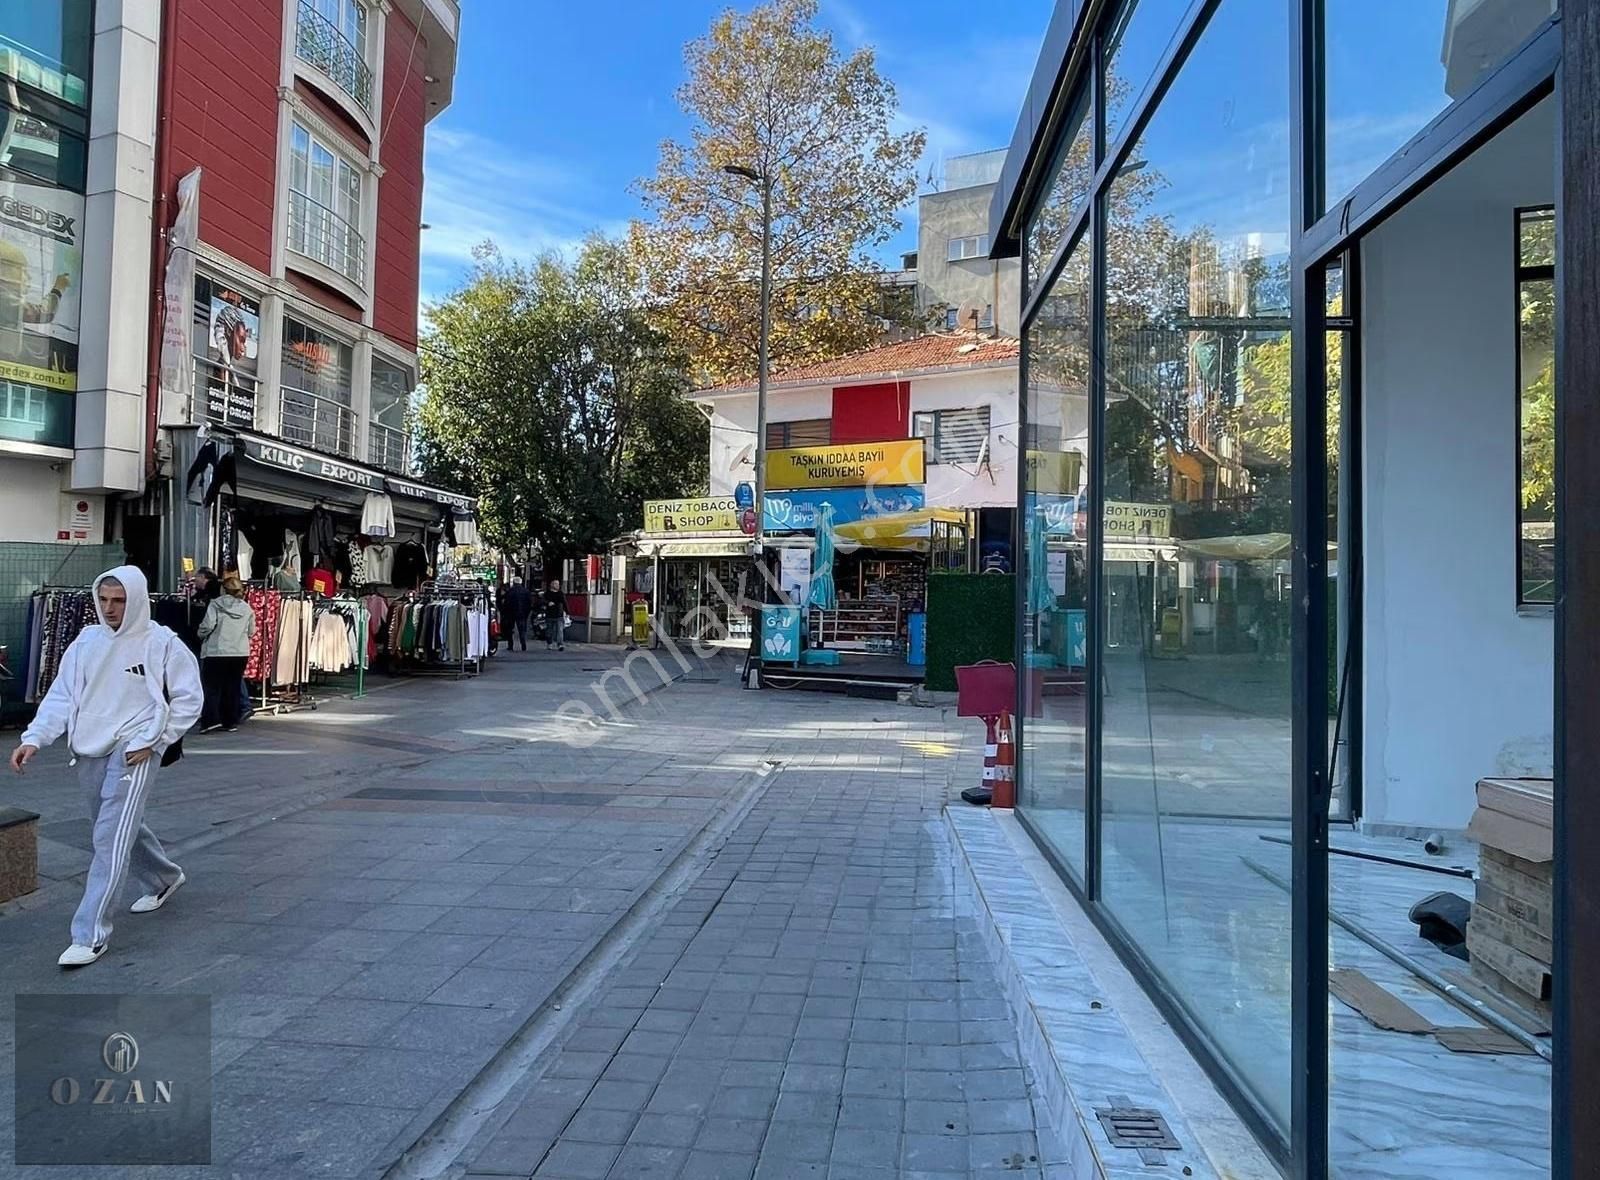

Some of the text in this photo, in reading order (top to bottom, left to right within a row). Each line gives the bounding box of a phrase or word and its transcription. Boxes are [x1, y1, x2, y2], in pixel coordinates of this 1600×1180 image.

[0, 195, 76, 237] GEDEX
[260, 445, 373, 486] KILIÇ EXPORT
[790, 455, 823, 468] TAŞKIN
[437, 494, 470, 508] EXPORT
[687, 501, 736, 513] TOBACC
[679, 515, 713, 527] SHOP
